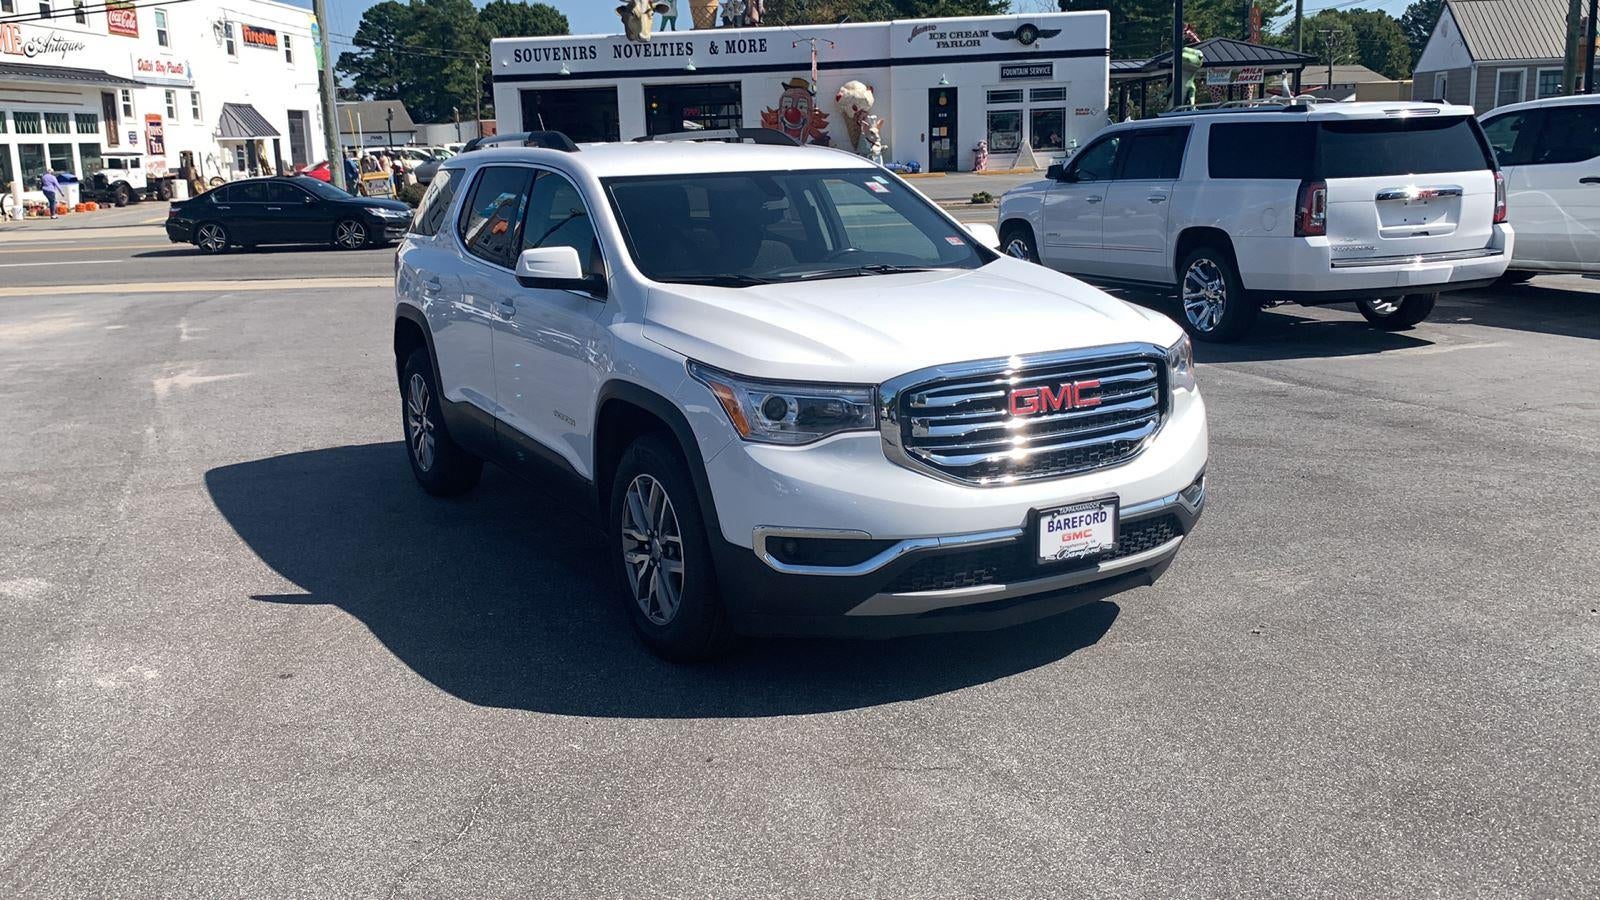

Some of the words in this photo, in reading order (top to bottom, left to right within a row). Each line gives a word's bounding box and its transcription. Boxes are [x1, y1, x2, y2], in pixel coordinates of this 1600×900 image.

[243, 24, 277, 46] Firestone
[929, 32, 947, 40] ICE
[949, 30, 989, 39] CREAM
[936, 39, 981, 48] PARLOR
[28, 30, 85, 60] Antiques
[514, 45, 597, 63] SOUVENIRS
[613, 42, 693, 58] NOVELTIES
[709, 40, 719, 55] &
[725, 38, 767, 54] MORE
[137, 58, 153, 72] Dutch
[155, 60, 166, 75] Boy
[167, 61, 184, 74] Paints
[1002, 68, 1029, 76] FOUNTAIN
[1029, 66, 1051, 75] SERVICE
[1009, 380, 1101, 416] GMC
[1047, 511, 1107, 533] BAREFORD
[1061, 529, 1093, 542] GMC
[1056, 543, 1103, 560] Bareford
